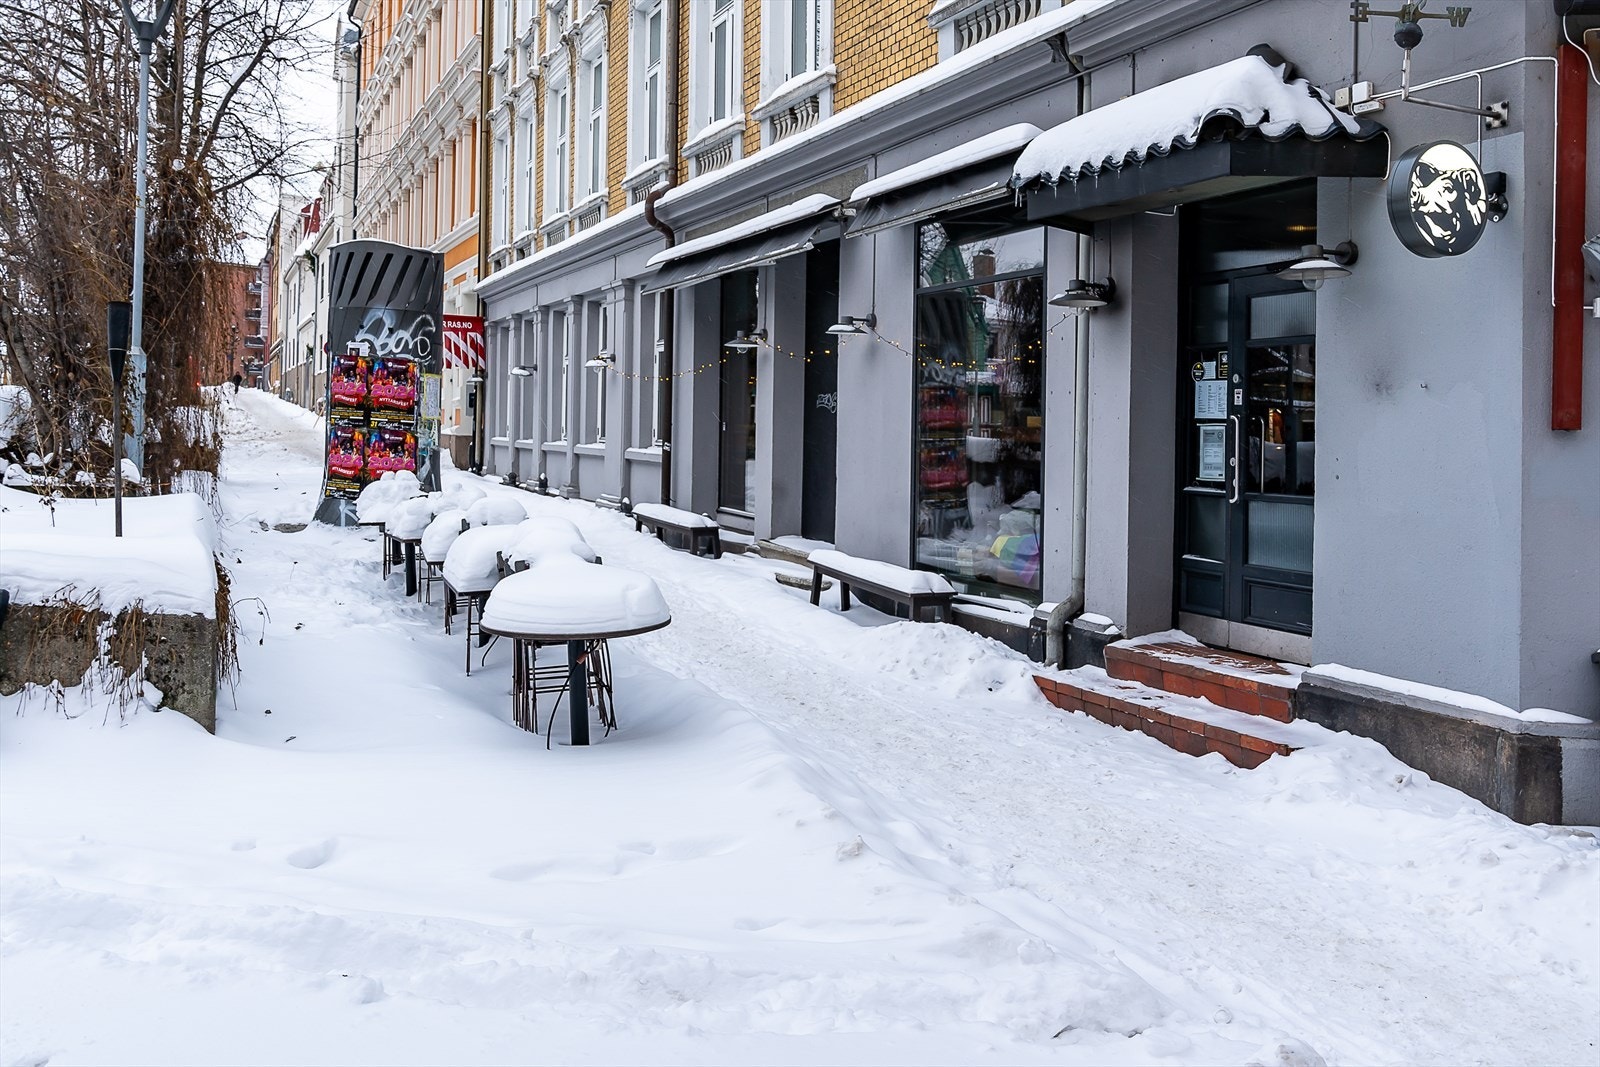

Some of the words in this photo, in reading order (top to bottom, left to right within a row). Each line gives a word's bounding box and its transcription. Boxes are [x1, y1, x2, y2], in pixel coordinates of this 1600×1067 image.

[1446, 7, 1472, 27] W
[448, 321, 473, 330] RAS.NO
[332, 381, 367, 396] 2024
[371, 384, 416, 399] 2024
[329, 453, 364, 468] 2024
[368, 456, 415, 471] 2024
